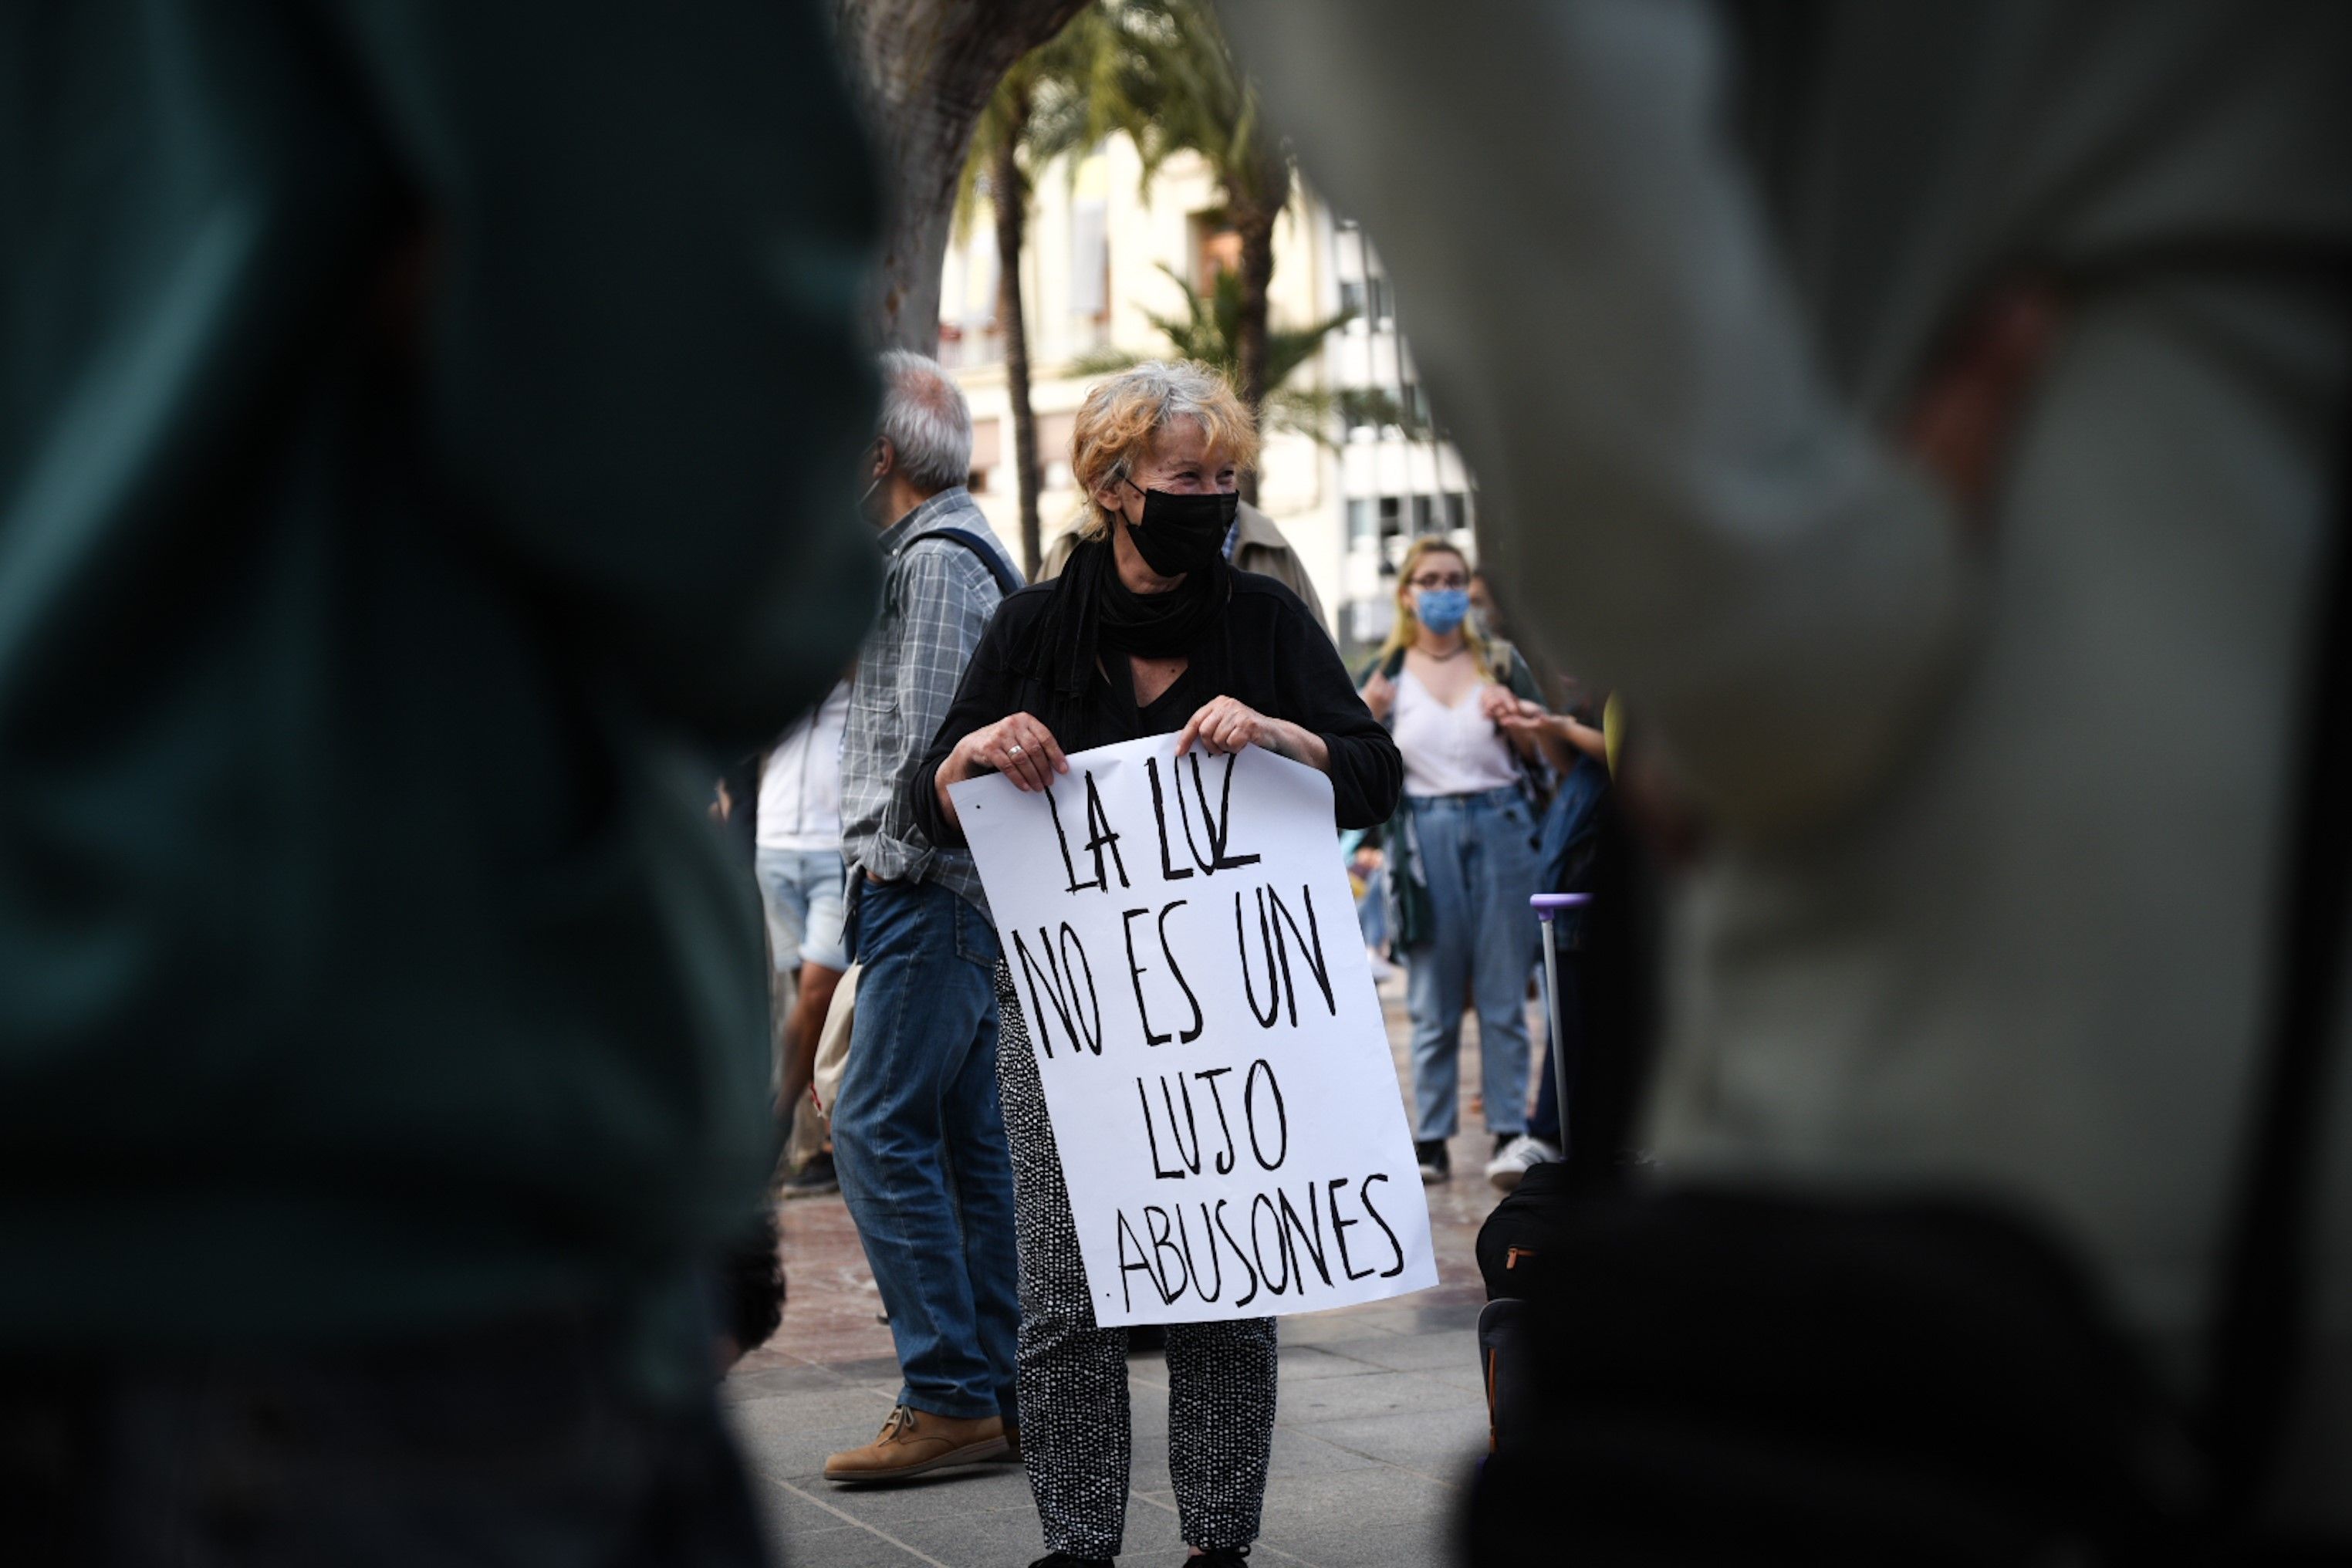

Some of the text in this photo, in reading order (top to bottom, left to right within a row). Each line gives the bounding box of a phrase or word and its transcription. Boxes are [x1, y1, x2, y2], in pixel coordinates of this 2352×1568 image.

[1044, 752, 1261, 894] LA LUZ
[1012, 883, 1336, 1059] NO ES UN
[1137, 1058, 1287, 1179] LUJO
[1117, 1173, 1404, 1313] ABUSONES
